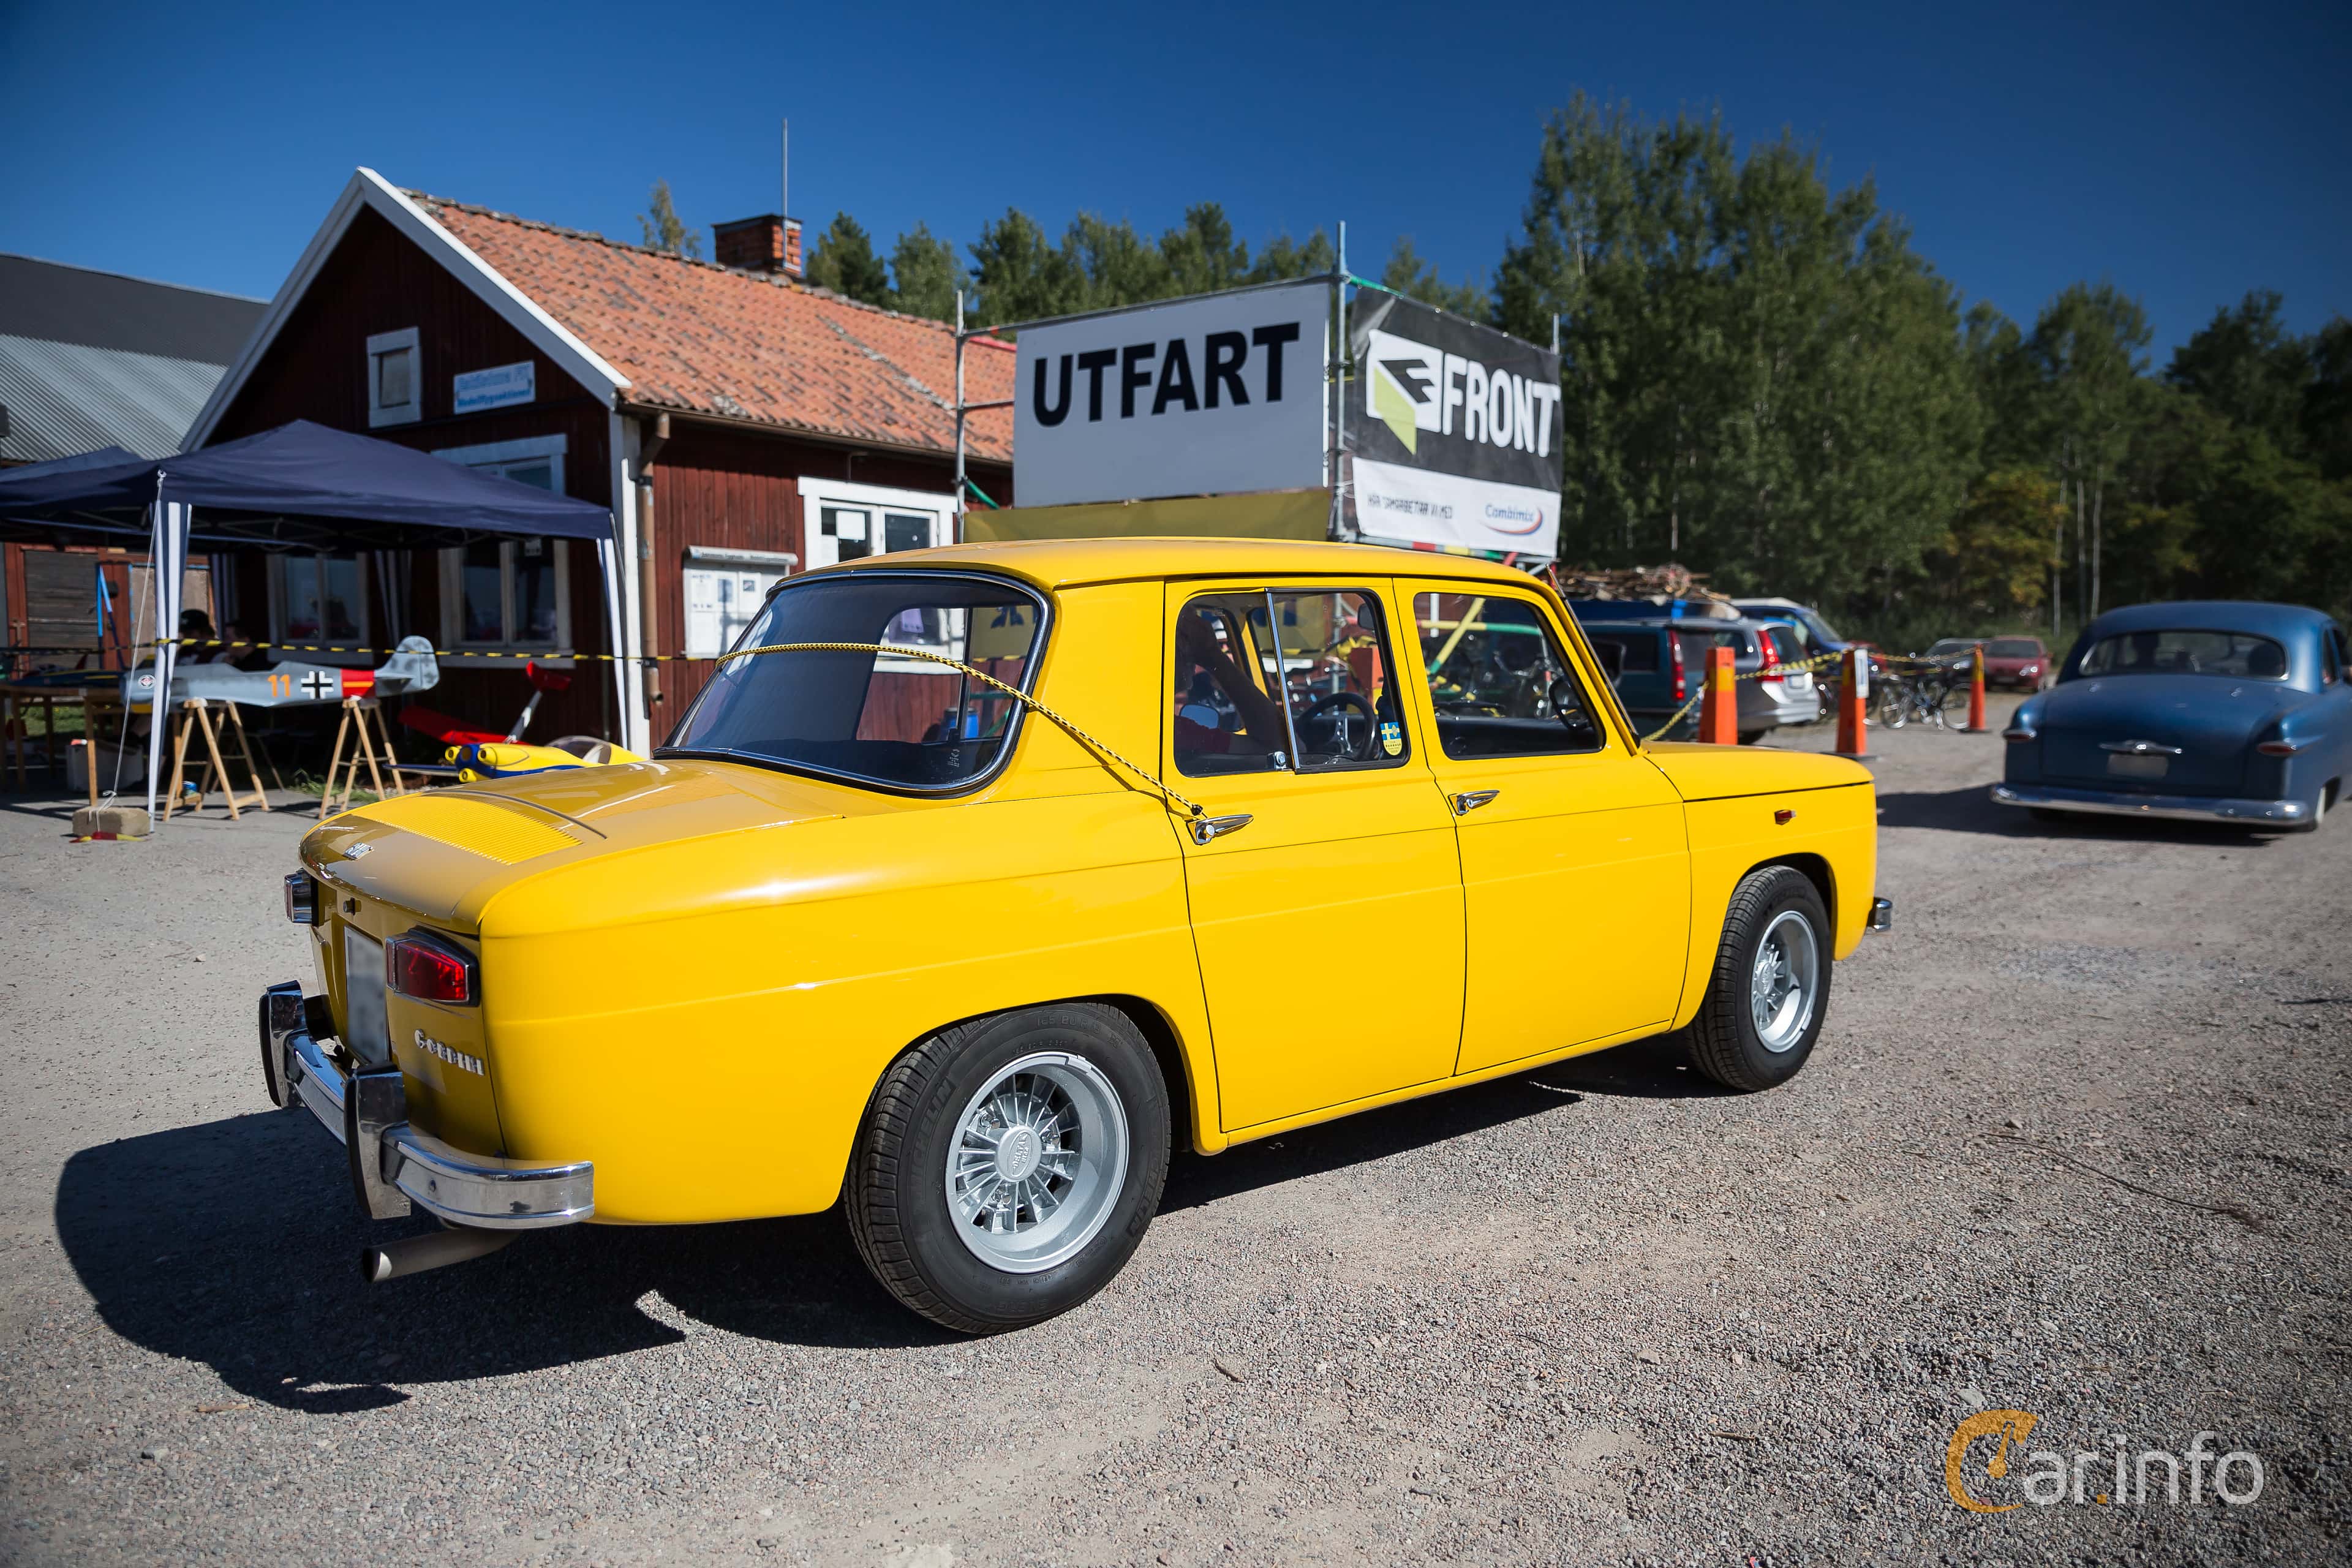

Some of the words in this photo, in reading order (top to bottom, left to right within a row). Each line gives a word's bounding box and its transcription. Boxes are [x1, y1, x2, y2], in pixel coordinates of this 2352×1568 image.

[1033, 321, 1300, 428] UTFART
[1442, 352, 1562, 458] FRONT
[1485, 503, 1534, 522] Combimix
[267, 673, 291, 698] 11
[910, 1076, 954, 1189] MICHELIN
